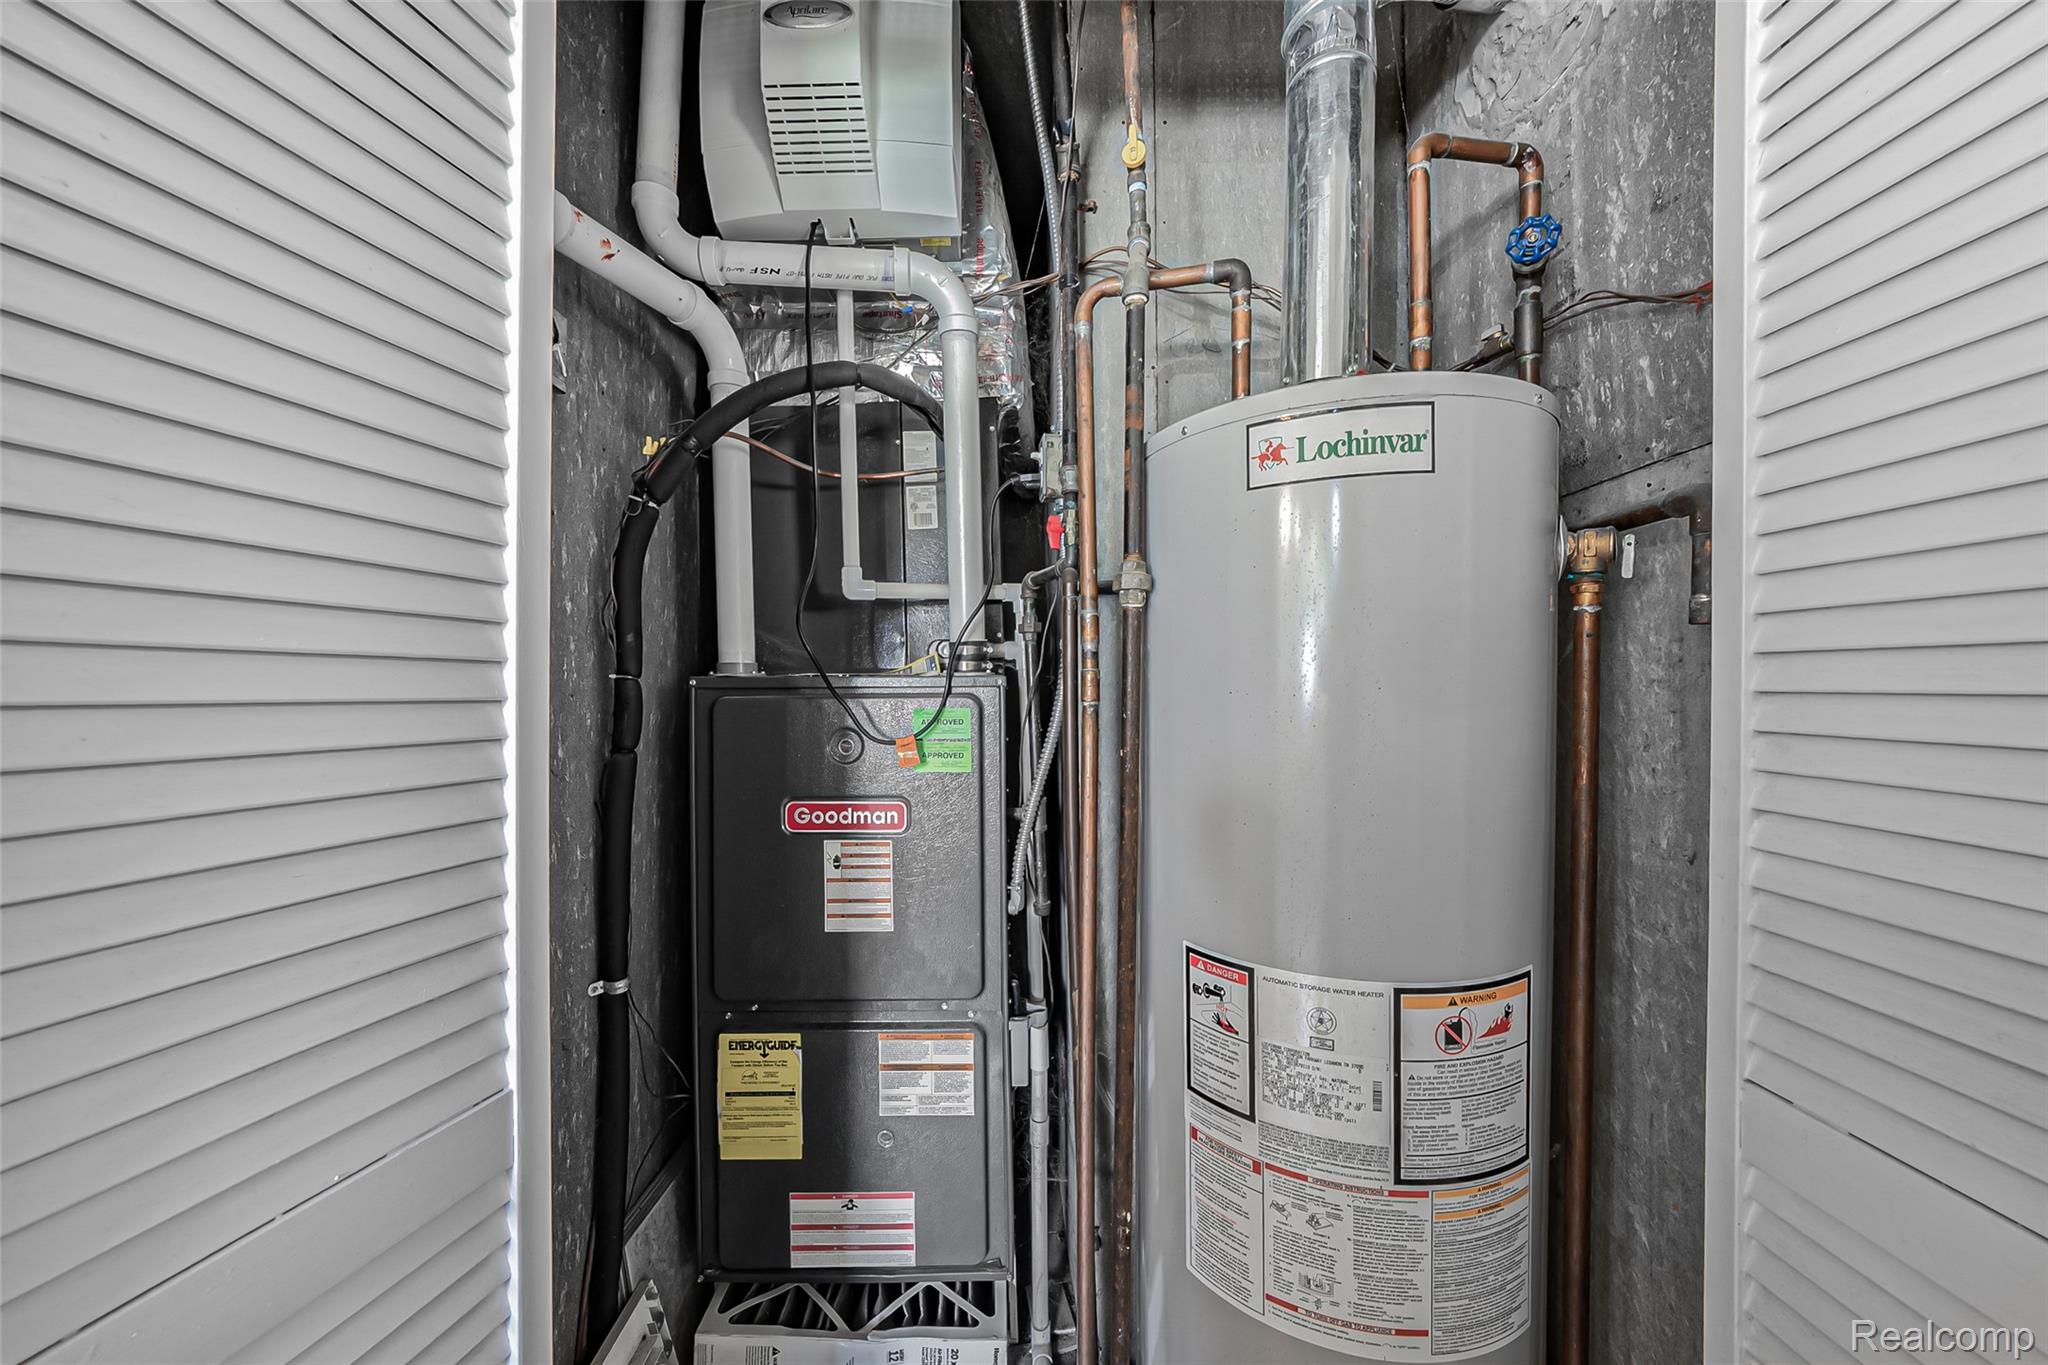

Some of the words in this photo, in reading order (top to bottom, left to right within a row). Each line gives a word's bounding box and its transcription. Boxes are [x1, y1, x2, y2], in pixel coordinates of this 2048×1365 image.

[748, 267, 781, 275] NSF
[1296, 428, 1428, 463] Lochinvar
[793, 807, 899, 825] Goodman
[1206, 965, 1240, 982] DANGER
[1262, 976, 1298, 989] AUTOMATIC
[1299, 983, 1331, 994] STORAGE
[1332, 988, 1356, 997] WATER
[1459, 992, 1497, 1004] WARNING
